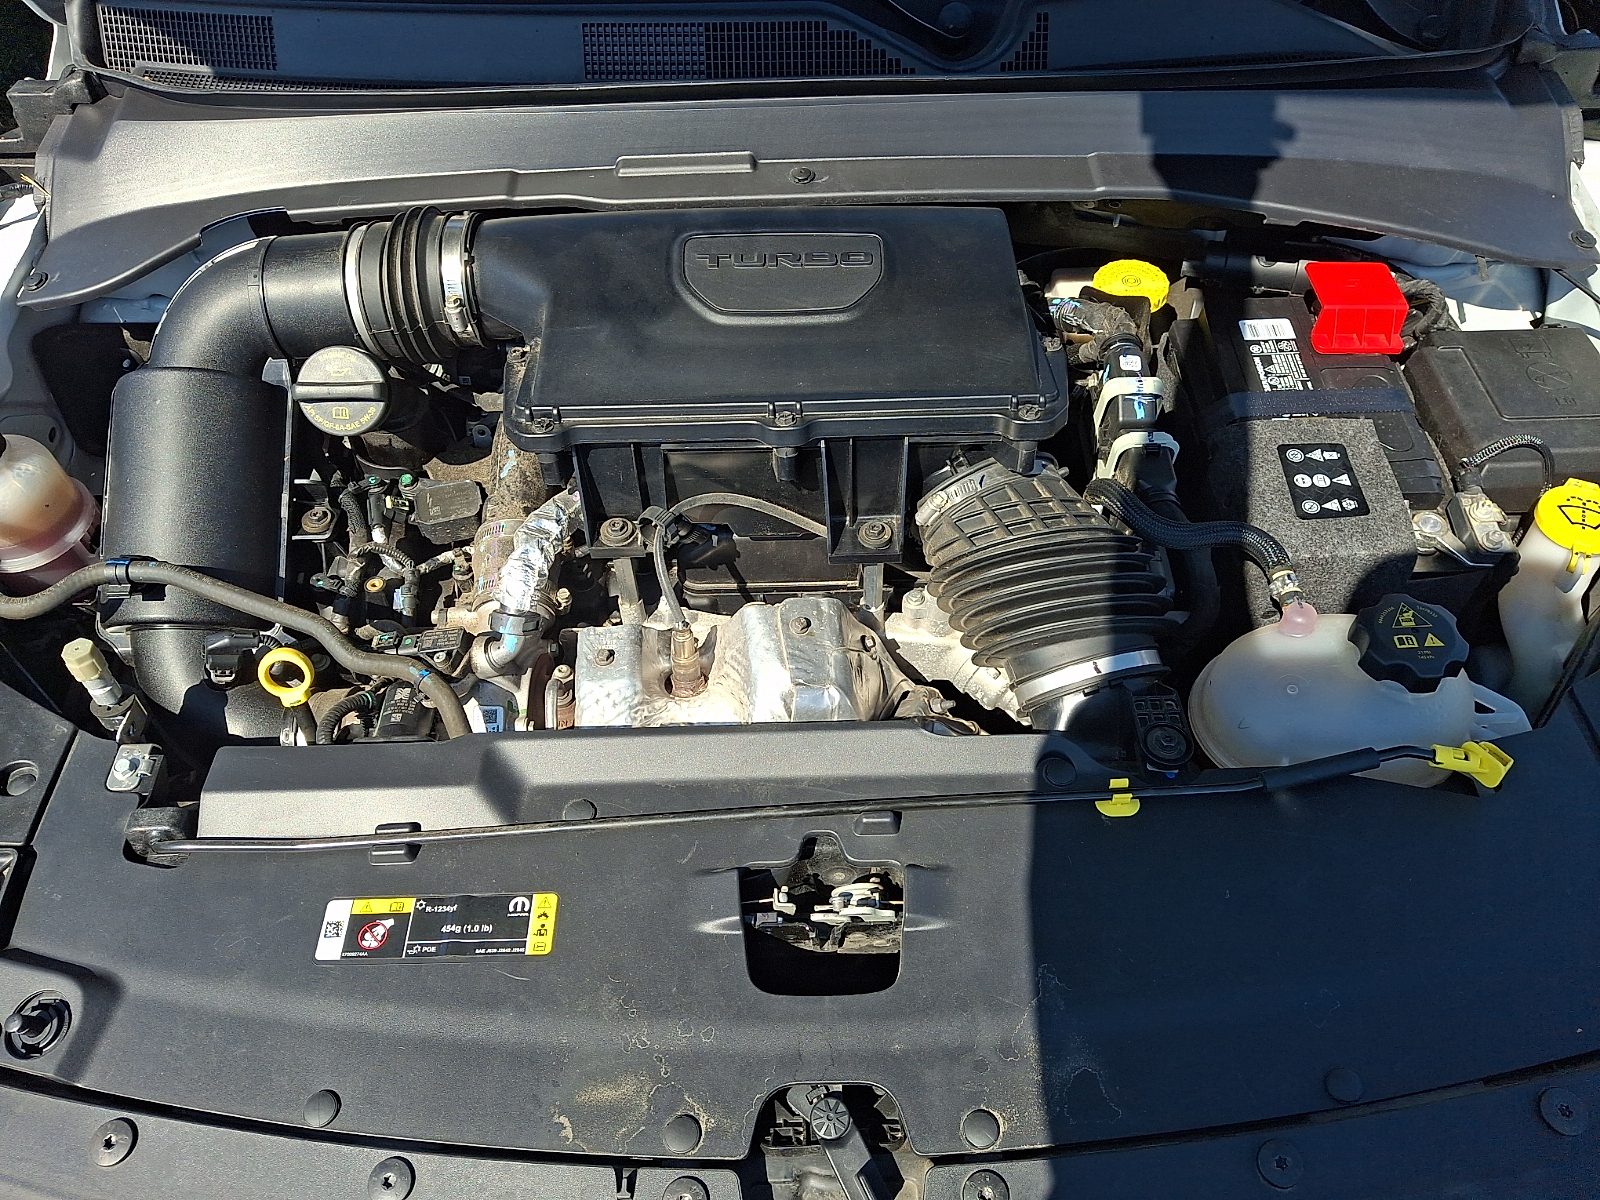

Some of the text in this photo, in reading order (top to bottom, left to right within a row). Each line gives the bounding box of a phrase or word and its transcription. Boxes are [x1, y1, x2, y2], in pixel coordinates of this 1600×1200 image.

[696, 251, 873, 270] TURBO
[425, 904, 458, 913] R-1234yf
[441, 924, 493, 934] 454g (1.0 lb)
